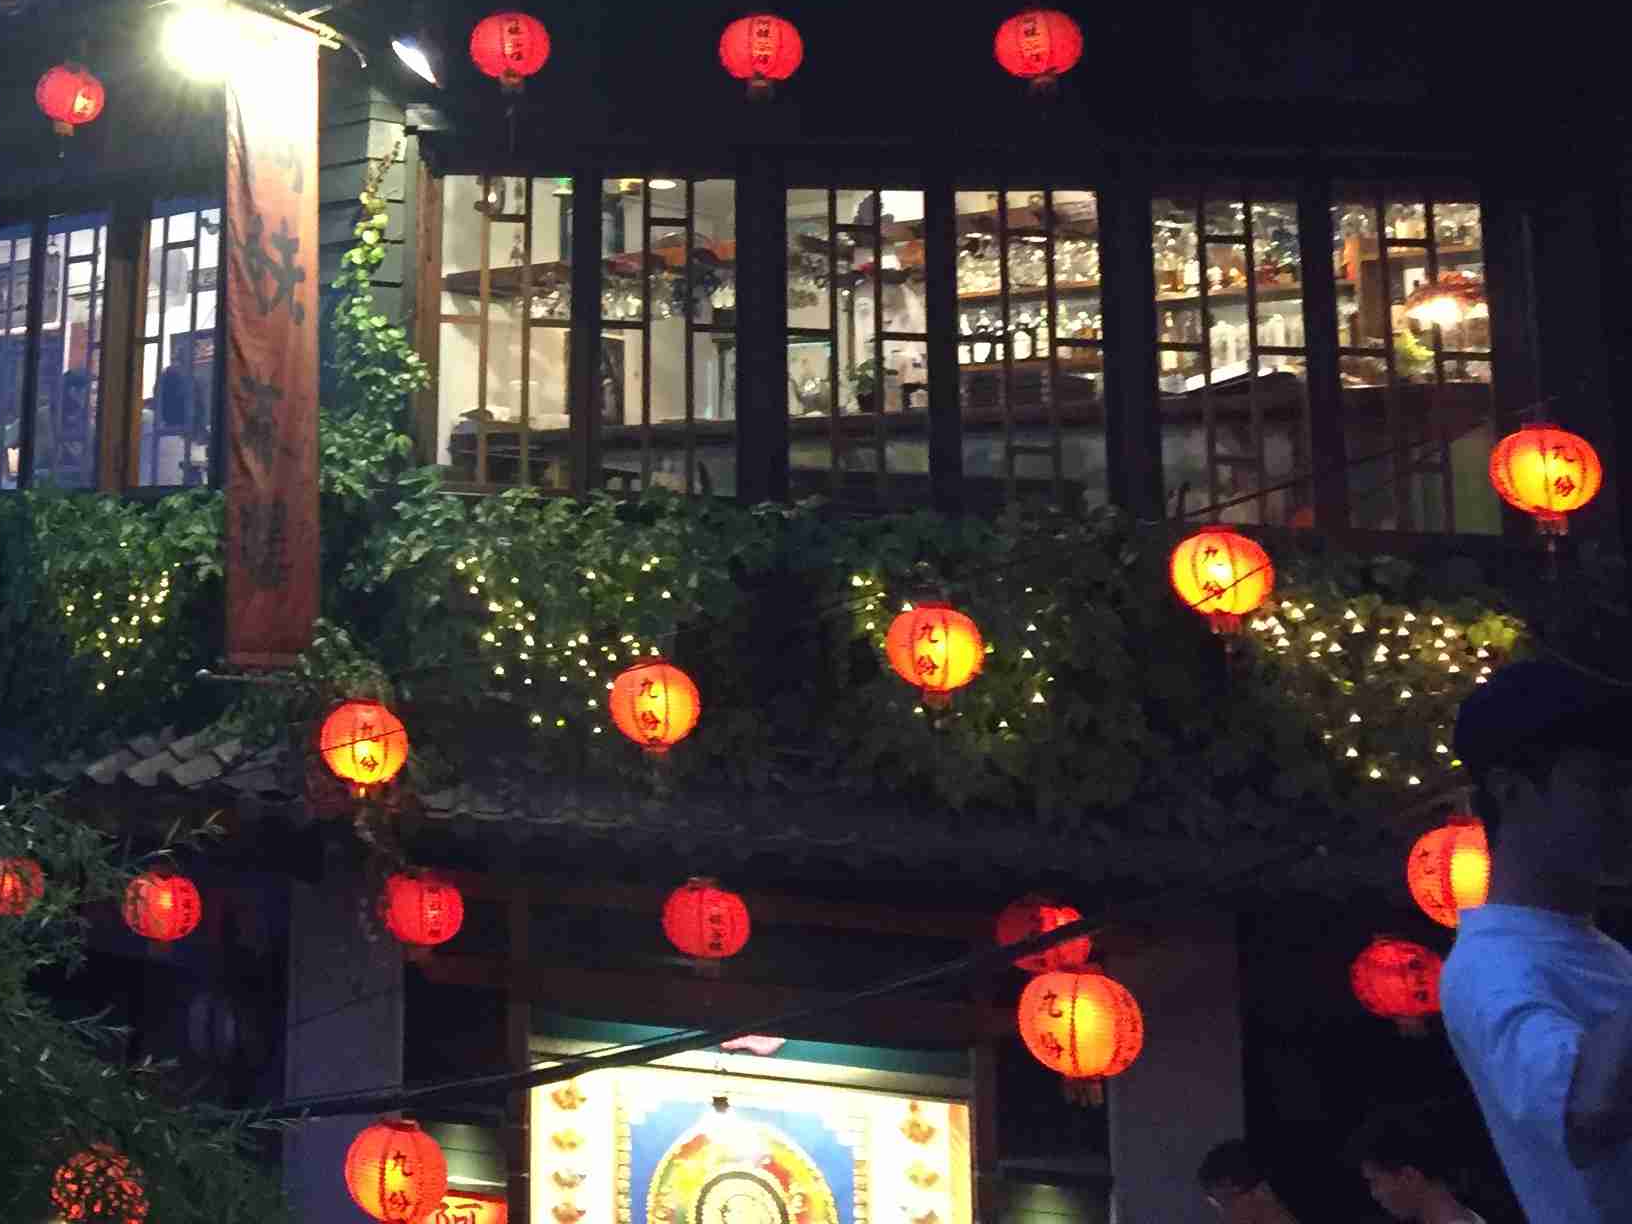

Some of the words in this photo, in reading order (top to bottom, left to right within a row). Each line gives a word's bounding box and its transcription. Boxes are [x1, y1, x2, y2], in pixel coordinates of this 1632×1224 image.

[1551, 445, 1576, 497] 九份
[917, 623, 939, 676] 九份
[639, 677, 661, 731] 九份
[1038, 989, 1065, 1060] 九份
[386, 1150, 414, 1209] 九份
